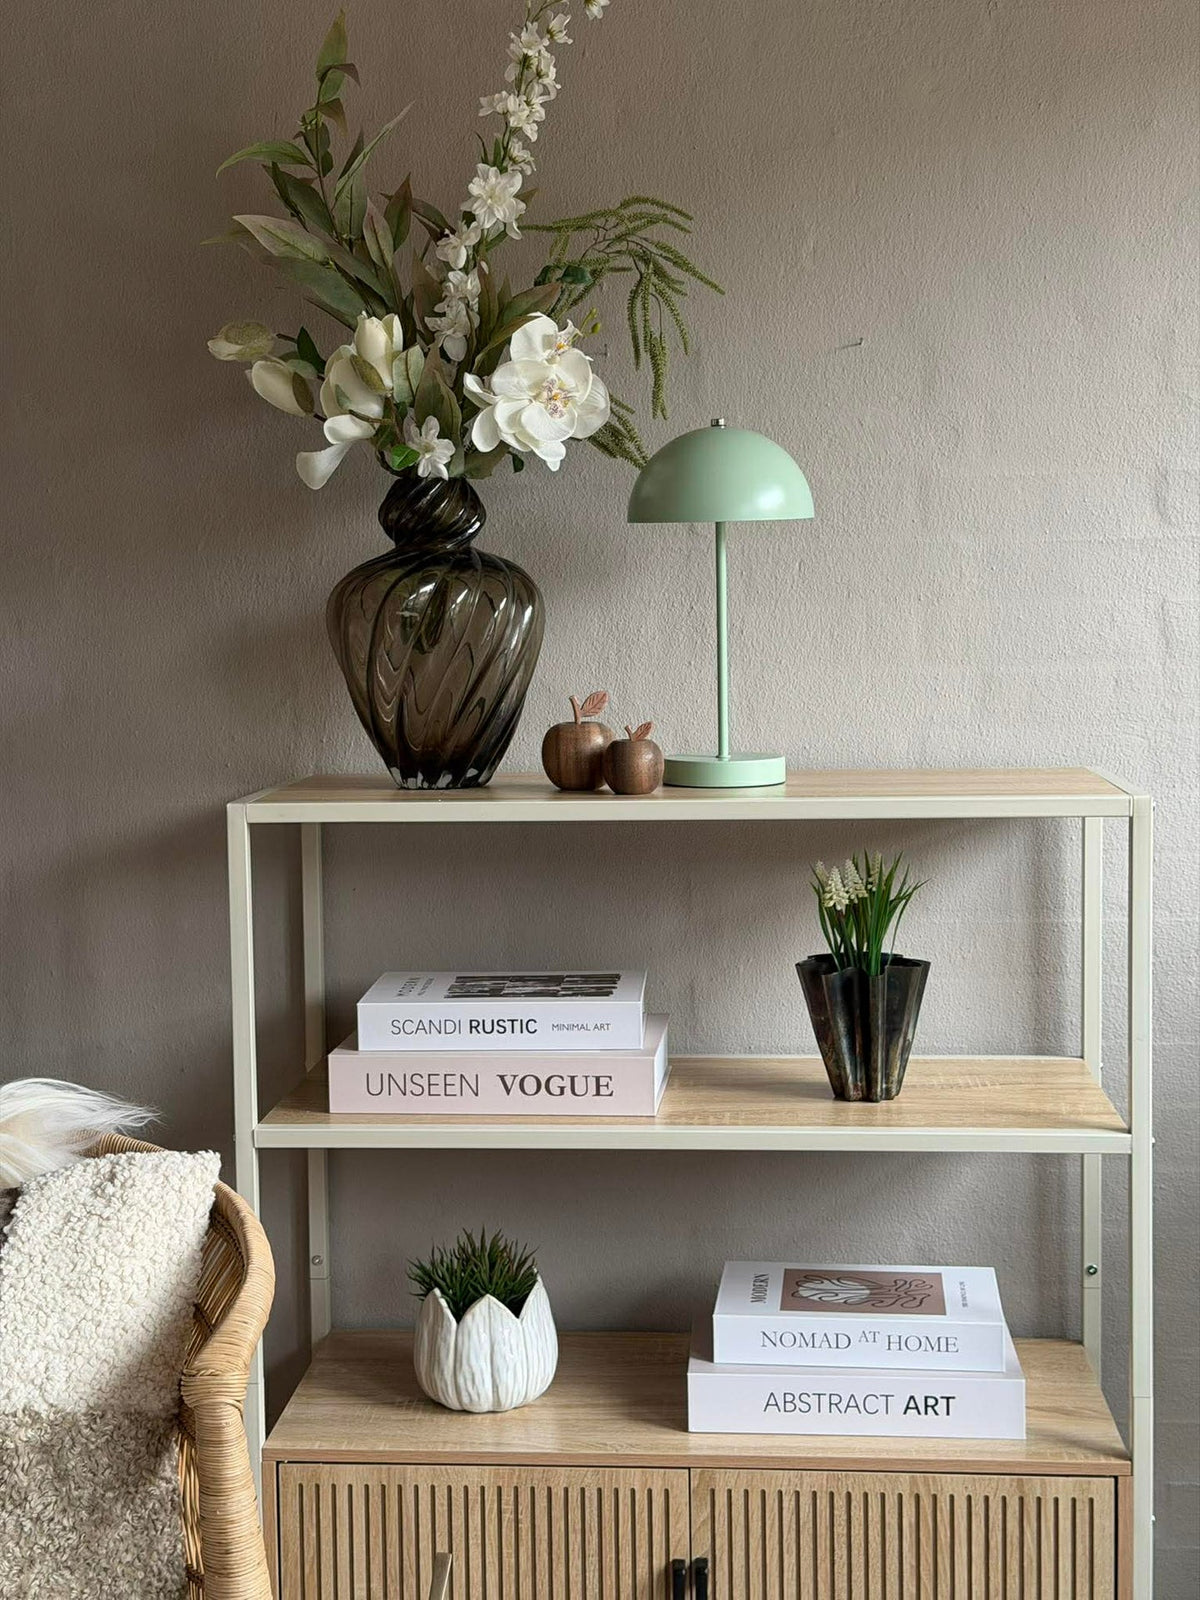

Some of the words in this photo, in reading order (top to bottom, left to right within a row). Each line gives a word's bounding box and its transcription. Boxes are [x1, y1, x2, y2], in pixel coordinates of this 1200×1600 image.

[391, 1018, 461, 1036] SCANDI
[469, 1018, 537, 1035] RUSTIC
[551, 1022, 591, 1032] MINIMAL
[593, 1022, 611, 1032] ART
[366, 1072, 478, 1097] UNSEEN
[496, 1074, 614, 1098] VOGUE
[761, 1330, 851, 1350] NOMAD
[858, 1330, 881, 1344] AT
[886, 1334, 959, 1353] HOME
[763, 1391, 895, 1415] ABSTRACT
[902, 1394, 957, 1417] ART
